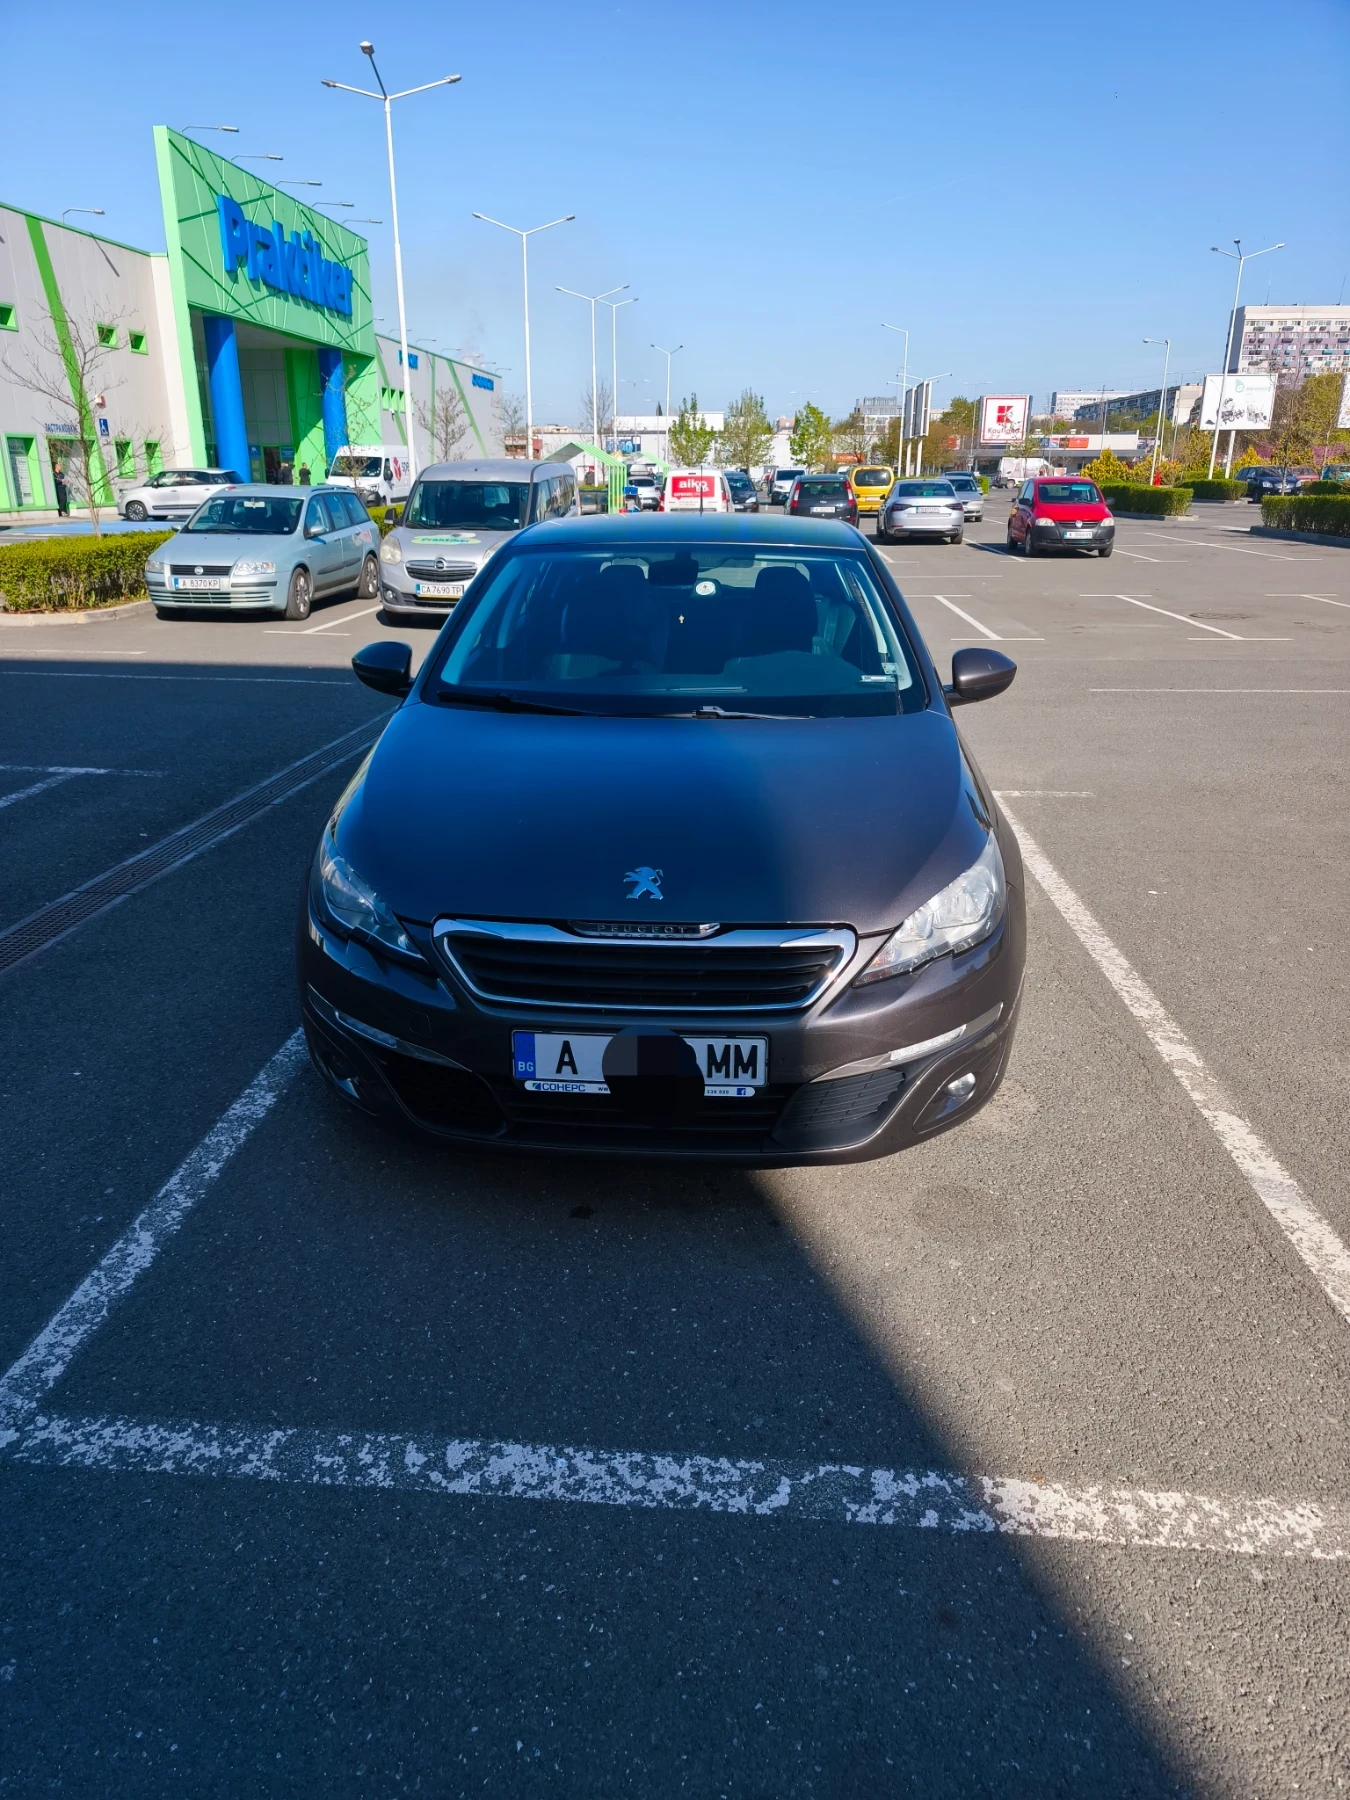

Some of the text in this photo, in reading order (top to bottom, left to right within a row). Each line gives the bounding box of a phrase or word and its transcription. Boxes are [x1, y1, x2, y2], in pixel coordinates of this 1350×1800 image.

[216, 194, 353, 316] Praktiker
[598, 924, 687, 934] PEUGEOT
[518, 1061, 534, 1072] BG
[555, 1040, 758, 1079] A MM
